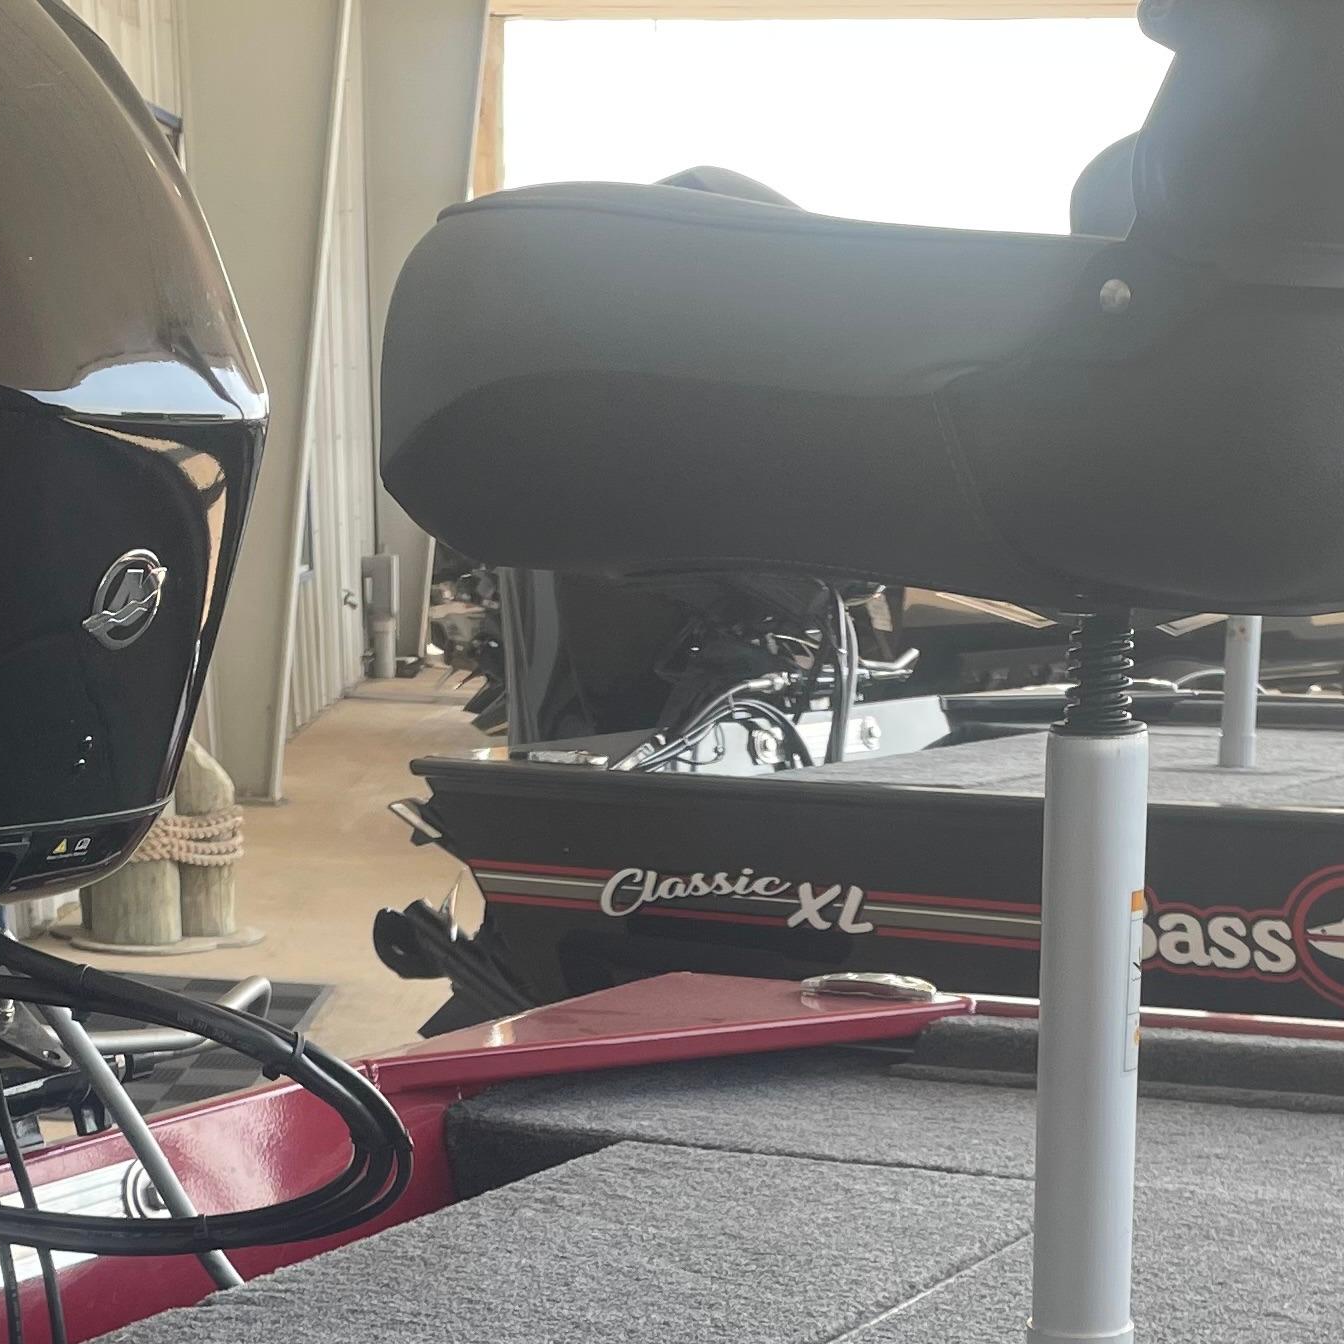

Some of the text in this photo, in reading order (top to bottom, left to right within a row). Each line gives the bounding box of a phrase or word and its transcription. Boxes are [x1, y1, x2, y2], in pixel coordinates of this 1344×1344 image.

[600, 867, 875, 935] Classic XL
[1141, 898, 1298, 974] ass
